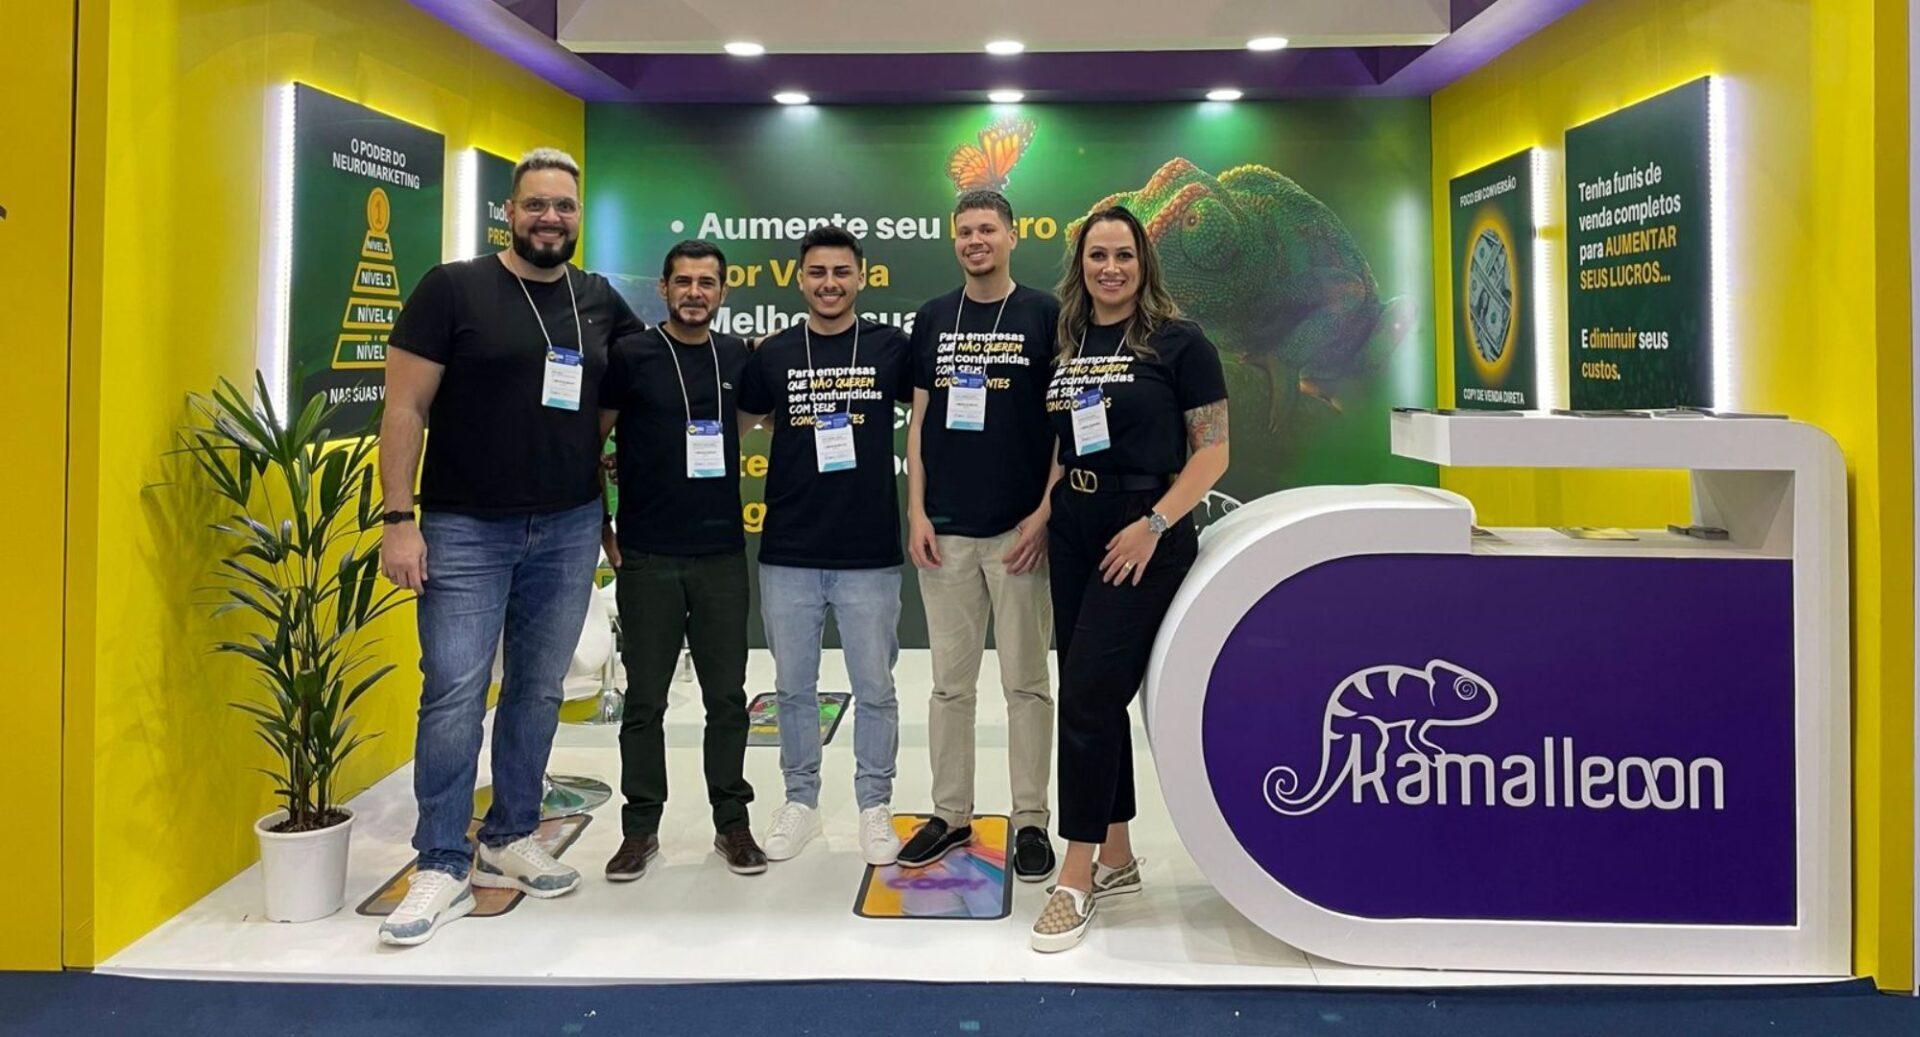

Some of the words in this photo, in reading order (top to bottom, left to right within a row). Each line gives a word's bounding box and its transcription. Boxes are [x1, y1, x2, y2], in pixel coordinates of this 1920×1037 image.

[351, 138, 359, 154] O
[360, 141, 391, 164] PODER
[393, 151, 407, 168] DO
[332, 151, 420, 190] NEUROMARKETING
[1579, 177, 1612, 202] Tenha
[1614, 166, 1643, 194] funis
[1645, 161, 1662, 186] de
[1579, 206, 1612, 231] venda
[1614, 194, 1681, 225] completos
[875, 215, 941, 239] seu
[1580, 242, 1603, 266] para
[1605, 225, 1677, 257] AUMENTAR
[361, 269, 385, 286] NÍVEL
[386, 274, 392, 287] 3
[1580, 267, 1608, 290] SEUS
[1610, 260, 1671, 287] LUCROS...
[357, 304, 386, 323] NÍVEL
[387, 309, 393, 323] 4
[937, 343, 955, 353] QUE
[958, 341, 981, 352] NÃO
[983, 343, 1022, 353] QUEREM
[939, 332, 964, 342] Para
[966, 332, 1025, 343] empresas
[1581, 328, 1589, 348] E
[1590, 327, 1637, 349] diminuir
[1638, 331, 1669, 349] seus
[356, 342, 385, 360] NÍVEL
[936, 354, 953, 364] ser
[955, 353, 1030, 366] confundidas
[788, 368, 815, 379] Para
[816, 367, 876, 377] empresas
[1582, 359, 1621, 380] custos.
[352, 384, 378, 403] SUAS
[788, 380, 807, 391] QUE
[810, 377, 832, 389] NÃO
[835, 377, 875, 388] QUEREM
[788, 393, 807, 402] ser
[809, 389, 882, 400] confundidas
[789, 404, 811, 414] COM
[813, 402, 836, 412] SEUS
